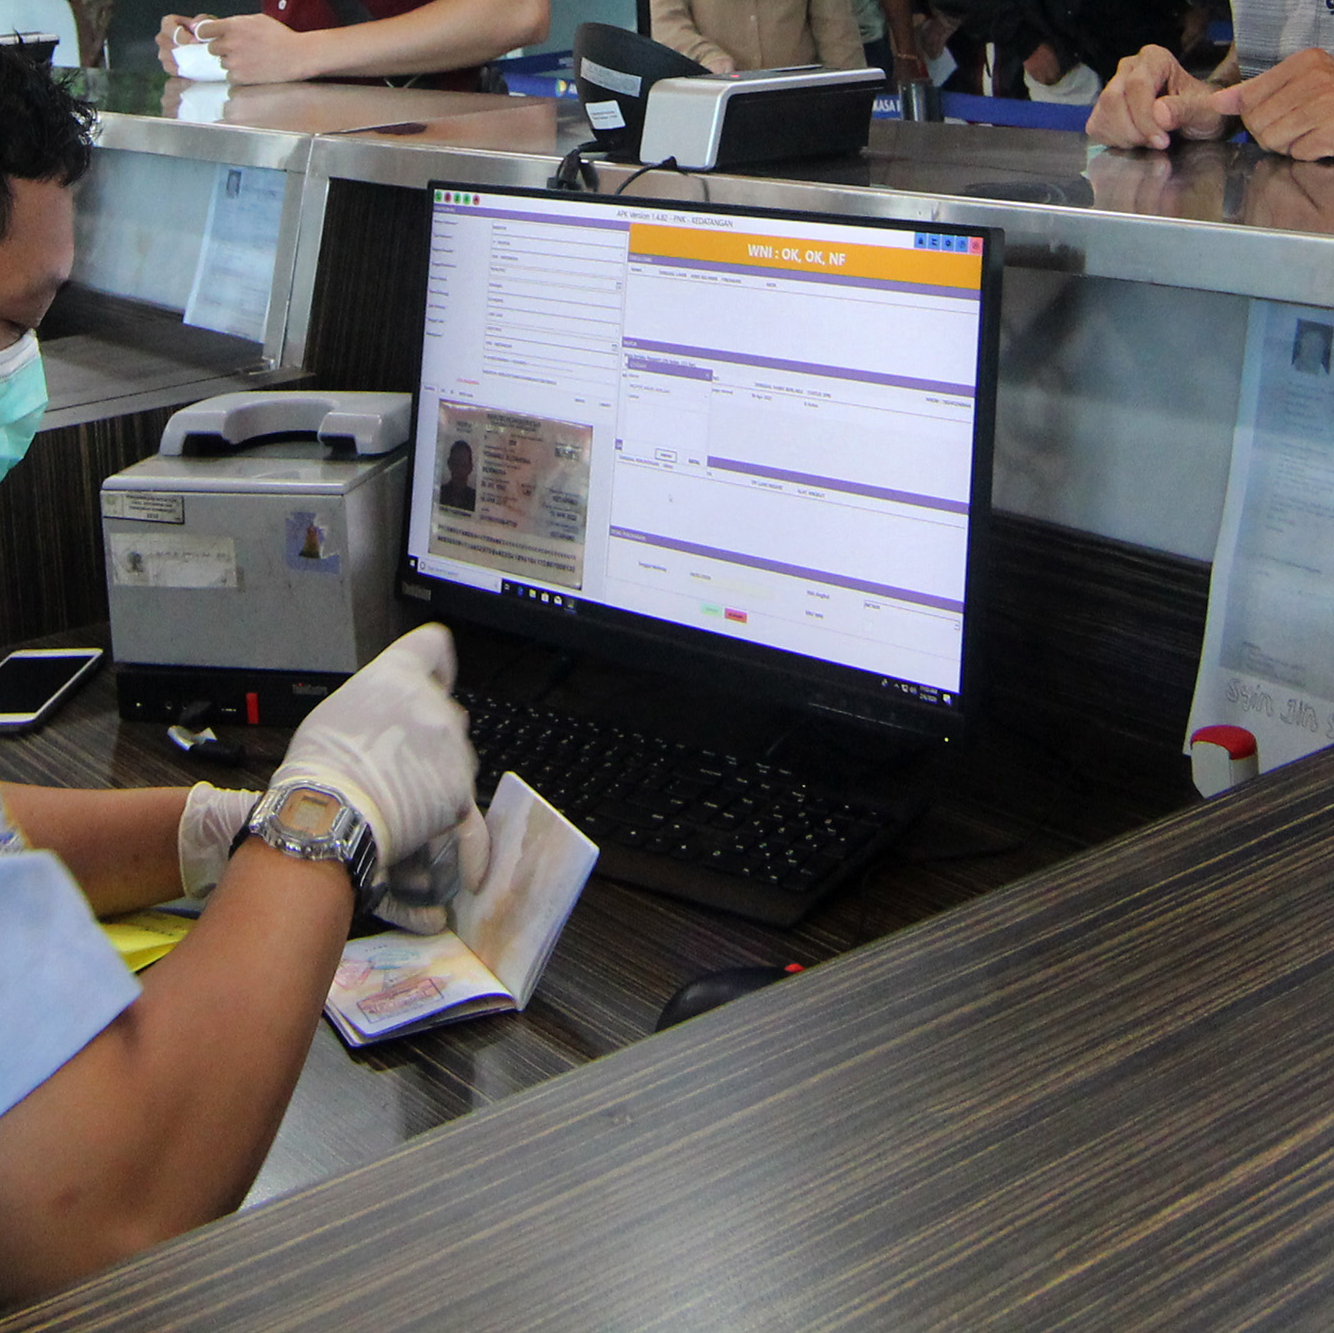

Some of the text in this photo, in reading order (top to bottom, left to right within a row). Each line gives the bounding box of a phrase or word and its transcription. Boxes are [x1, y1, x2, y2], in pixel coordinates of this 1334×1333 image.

[692, 216, 734, 228] KEDATANGAN
[747, 243, 773, 258] WNI
[781, 248, 802, 263] OK,
[805, 250, 826, 265] OK,
[828, 252, 847, 266] NF
